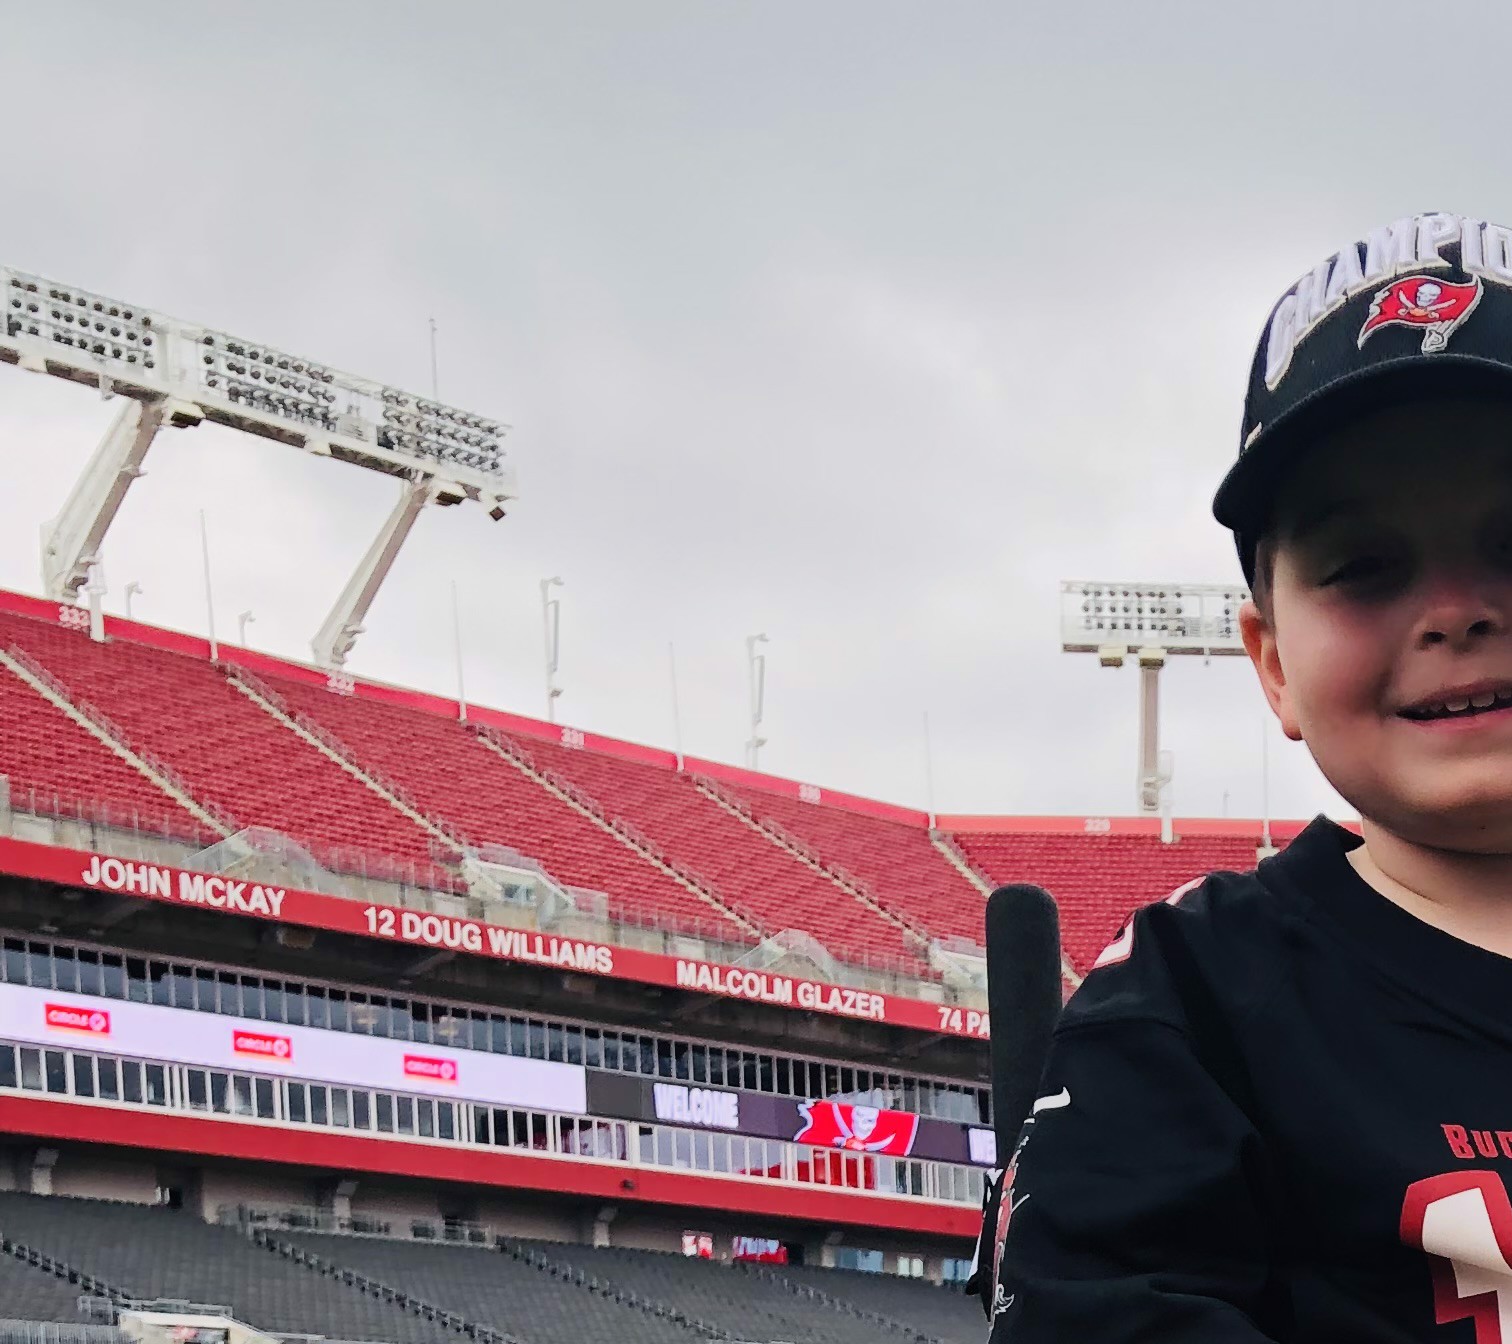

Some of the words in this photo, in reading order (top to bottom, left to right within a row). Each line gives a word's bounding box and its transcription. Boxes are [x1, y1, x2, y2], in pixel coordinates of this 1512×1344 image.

[82, 856, 171, 898] JOHN
[179, 873, 286, 916] MCKAY
[363, 907, 395, 937] 12
[402, 912, 482, 952] DOUG
[488, 927, 613, 974] WILLIAMS
[676, 961, 792, 1004] MALCOLM
[797, 982, 886, 1020] GLAZER
[938, 1006, 963, 1032] 74
[967, 1011, 990, 1036] PA
[653, 1082, 739, 1129] WELCOME
